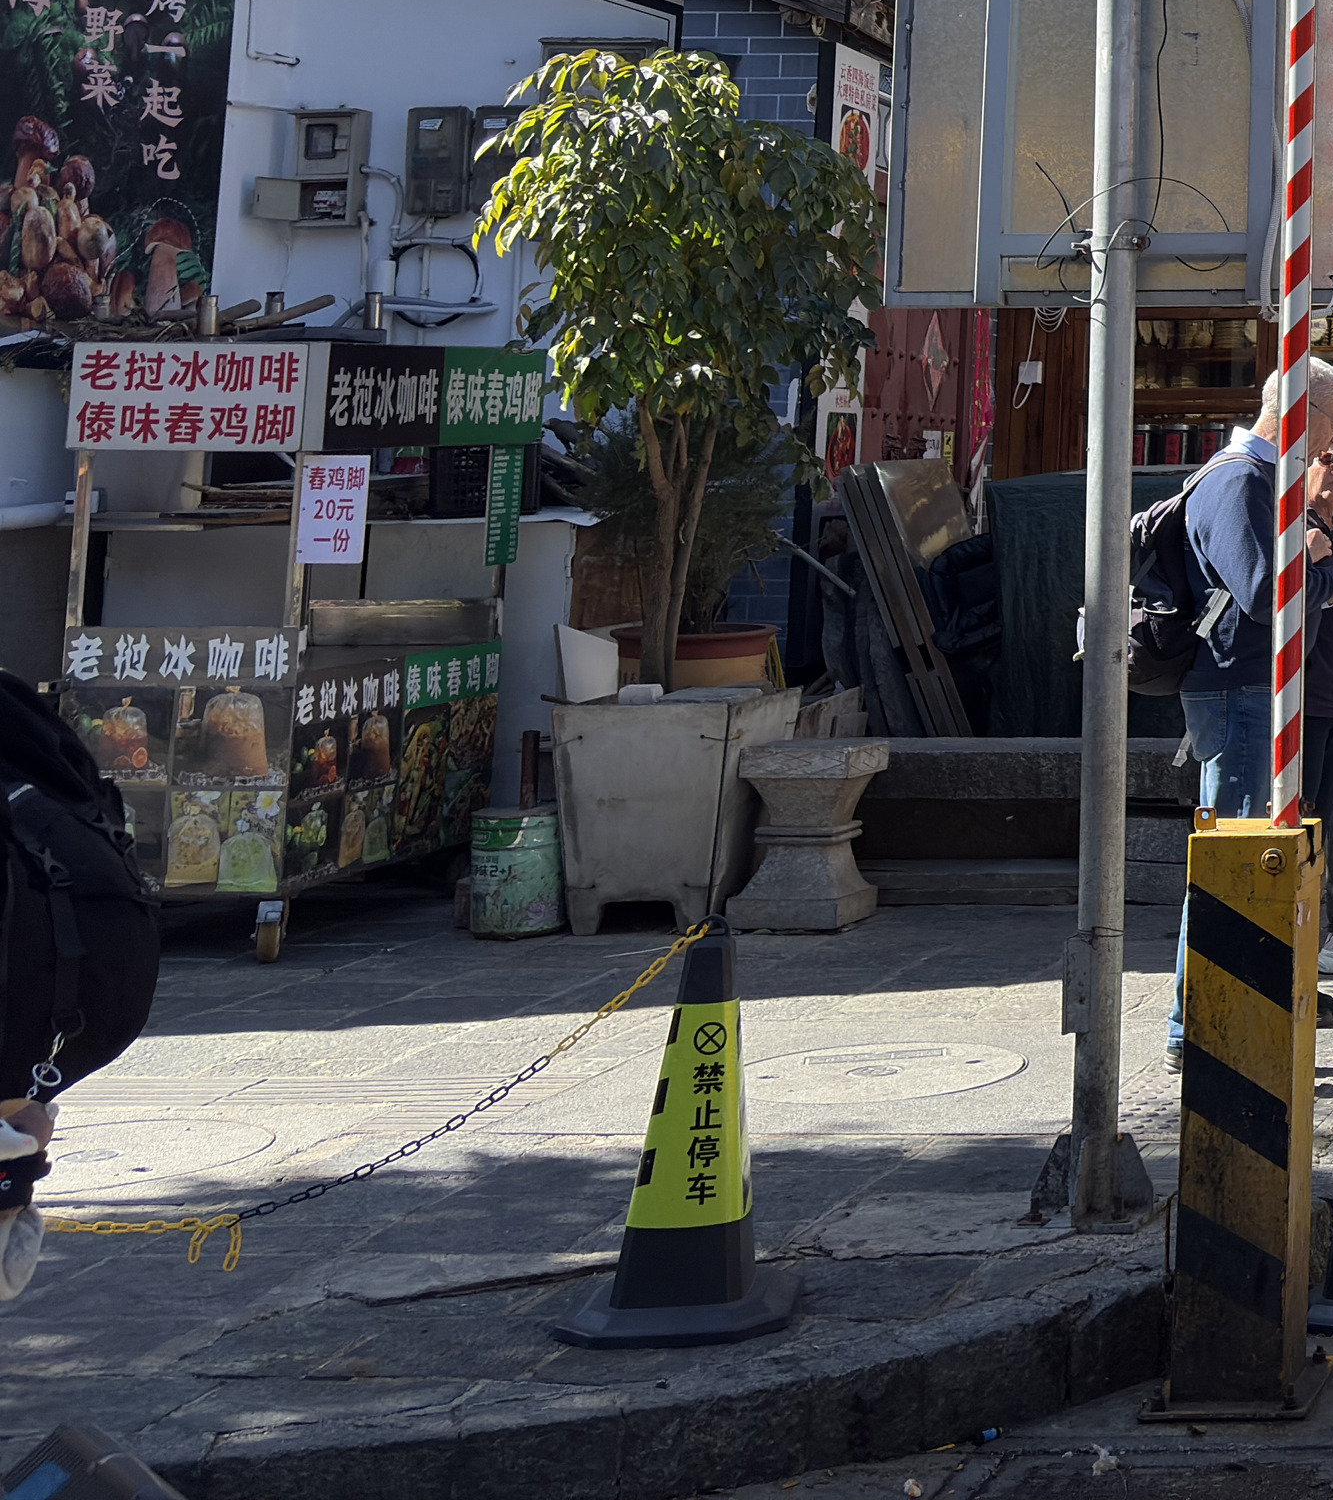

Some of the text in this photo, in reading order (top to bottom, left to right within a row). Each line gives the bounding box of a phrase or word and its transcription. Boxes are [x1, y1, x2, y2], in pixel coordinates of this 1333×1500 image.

[79, 349, 301, 394] 老挝冰咖啡
[329, 366, 439, 431] 老挝冰咖啡
[313, 498, 355, 522] 20元
[313, 528, 351, 553] 一份
[65, 632, 291, 682] 老挝冰咖啡
[295, 668, 400, 725] 老挝冰咖啡
[685, 1062, 726, 1206] 禁止停车
